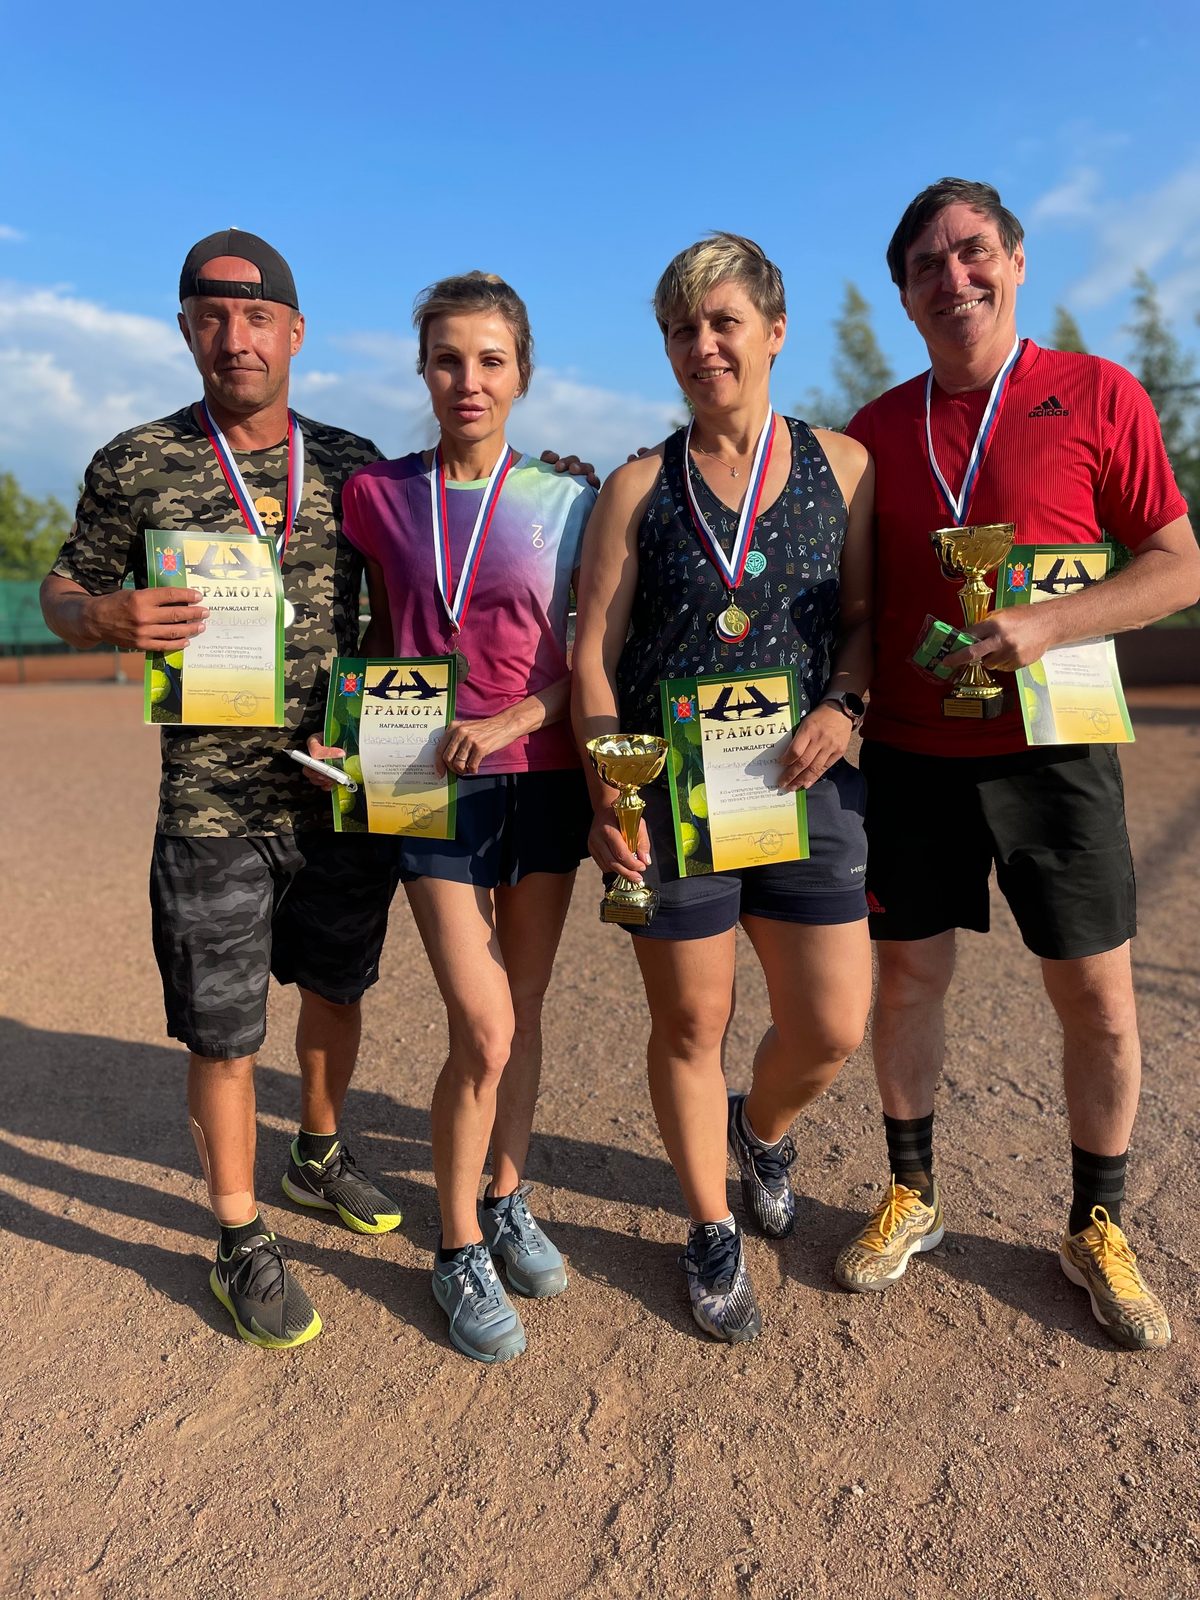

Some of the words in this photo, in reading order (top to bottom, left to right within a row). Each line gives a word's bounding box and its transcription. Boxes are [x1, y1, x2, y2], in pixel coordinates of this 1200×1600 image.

[1028, 409, 1070, 418] adidas
[364, 705, 443, 716] ГРАМОТА
[704, 722, 788, 741] ГРАМОТА
[723, 743, 775, 753] НАГРАЖДАЕТСЯ
